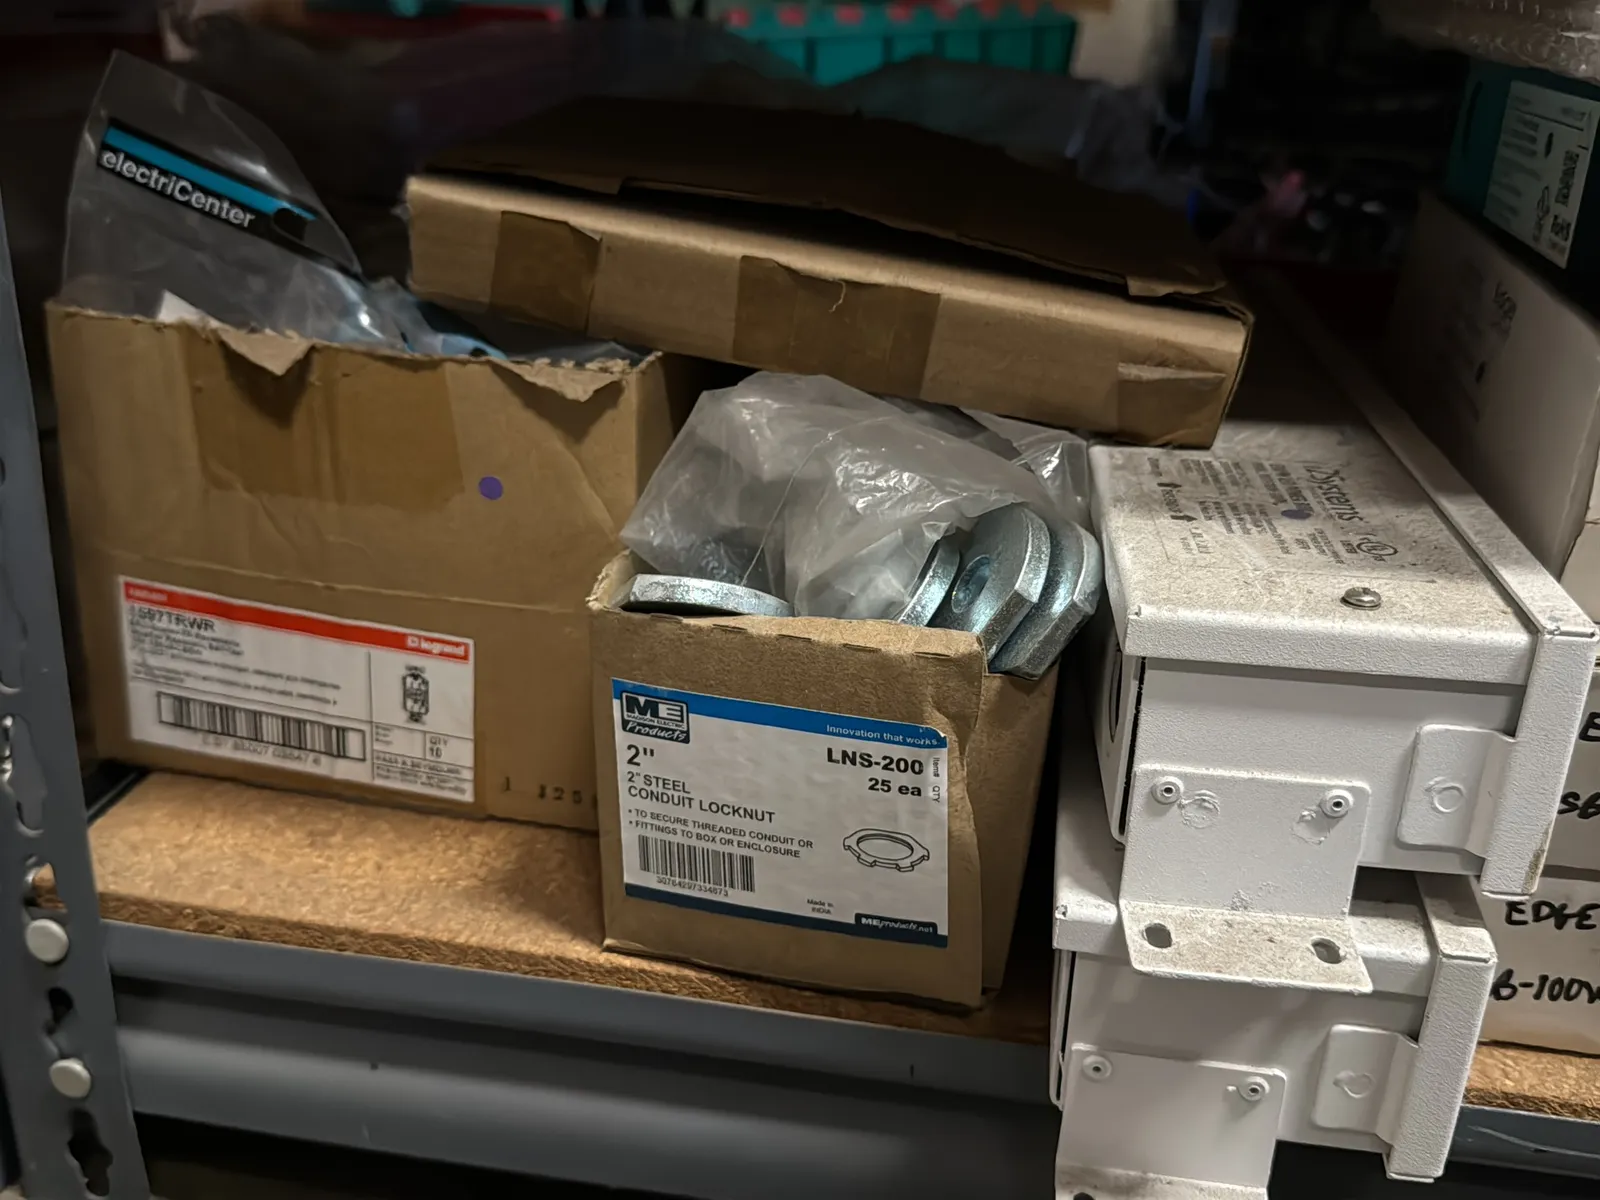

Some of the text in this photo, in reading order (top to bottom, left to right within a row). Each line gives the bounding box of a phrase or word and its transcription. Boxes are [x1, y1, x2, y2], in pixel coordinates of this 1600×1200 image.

[100, 149, 256, 228] electriCenter
[625, 695, 682, 722] ME
[626, 721, 687, 741] Products
[826, 724, 881, 739] Innovation
[883, 731, 904, 743] that
[625, 744, 655, 767] 2"
[827, 747, 924, 775] LNS-200
[643, 773, 691, 794] STEEL
[868, 777, 922, 796] 25 ea
[931, 785, 941, 803] QTY
[627, 785, 776, 823] CONDUIT LOCKNUT
[634, 808, 813, 848] TO SECURE THREADED CONDUIT OR
[635, 820, 800, 858] FITTINGS TO BOX OR ENCLOSURE
[807, 898, 826, 907] Made
